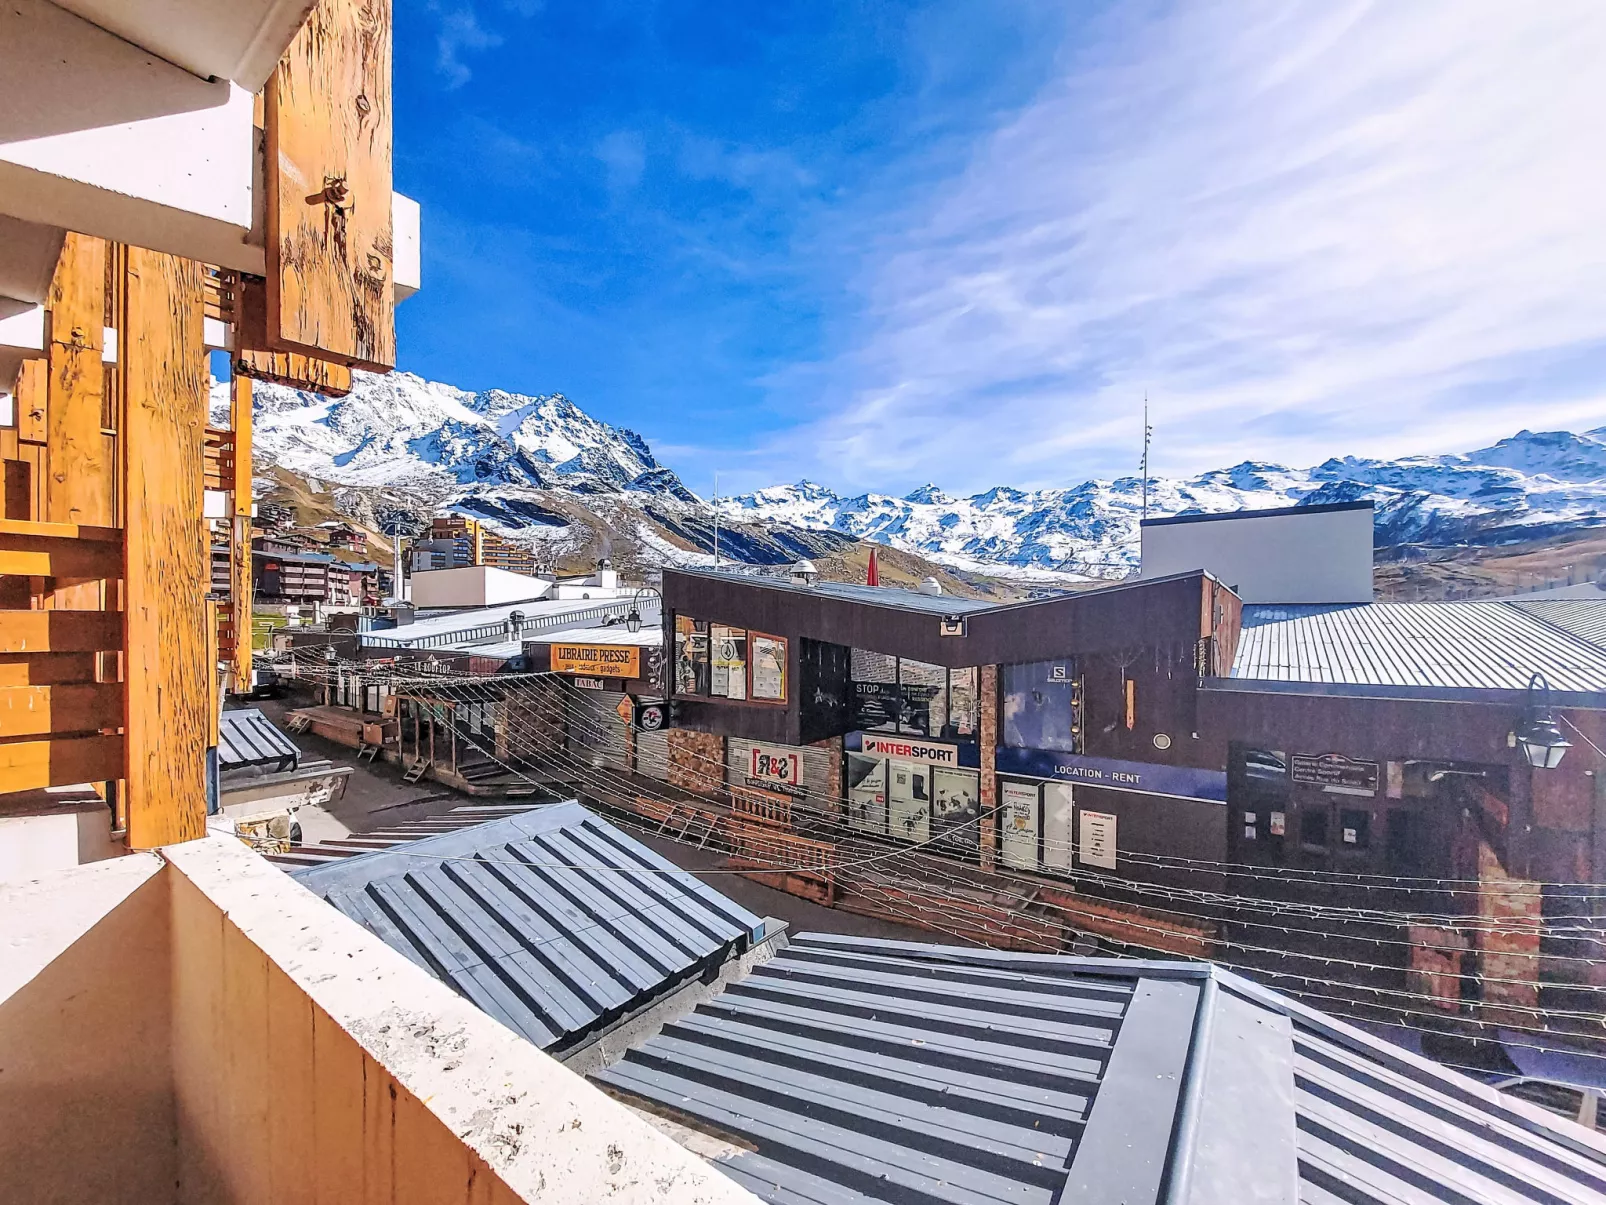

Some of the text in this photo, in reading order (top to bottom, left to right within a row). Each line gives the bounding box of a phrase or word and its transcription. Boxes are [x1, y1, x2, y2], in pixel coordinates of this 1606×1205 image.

[558, 647, 630, 664] LIBRAIRIE PRESSE
[856, 684, 879, 693] STOP
[876, 741, 953, 761] INTERSPORT
[1054, 765, 1102, 779] LOCATION
[1112, 772, 1142, 784] RENT
